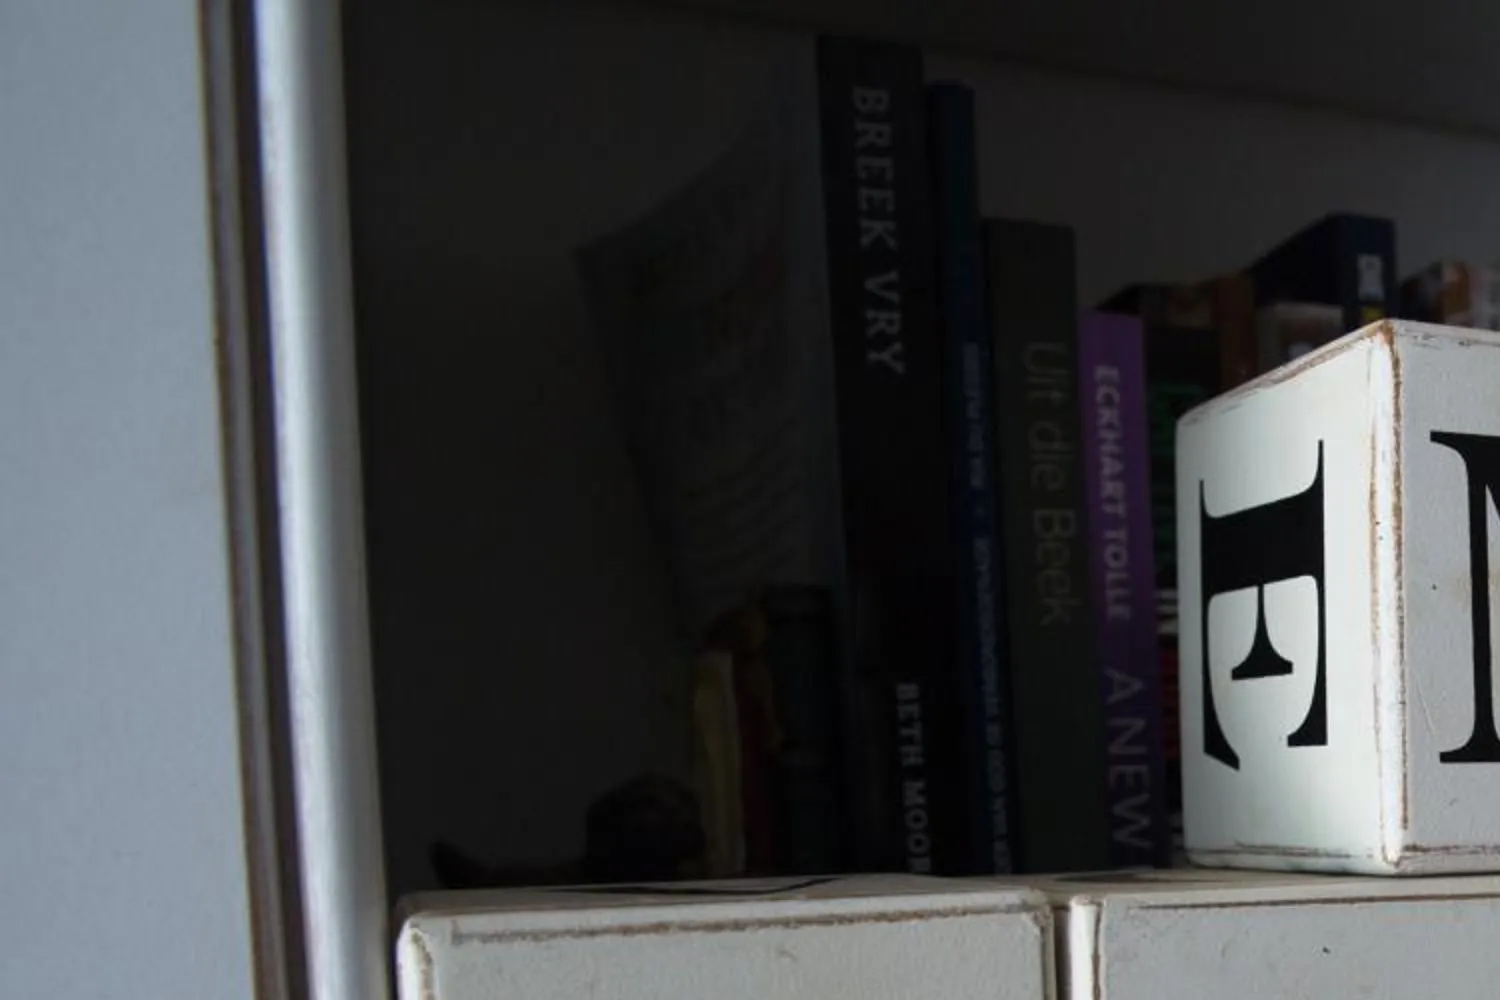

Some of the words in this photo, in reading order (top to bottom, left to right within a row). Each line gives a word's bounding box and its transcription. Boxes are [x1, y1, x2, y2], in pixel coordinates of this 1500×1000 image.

[850, 85, 897, 251] BREEK
[862, 270, 908, 377] VRY
[1022, 340, 1071, 406] Uit
[1027, 419, 1077, 492] die
[1093, 364, 1128, 517] ECKHART
[1033, 507, 1082, 626] Beek
[1101, 527, 1133, 624] TOLLE
[1199, 440, 1328, 772] E
[896, 682, 926, 768] BETH
[1106, 715, 1153, 852] NEW
